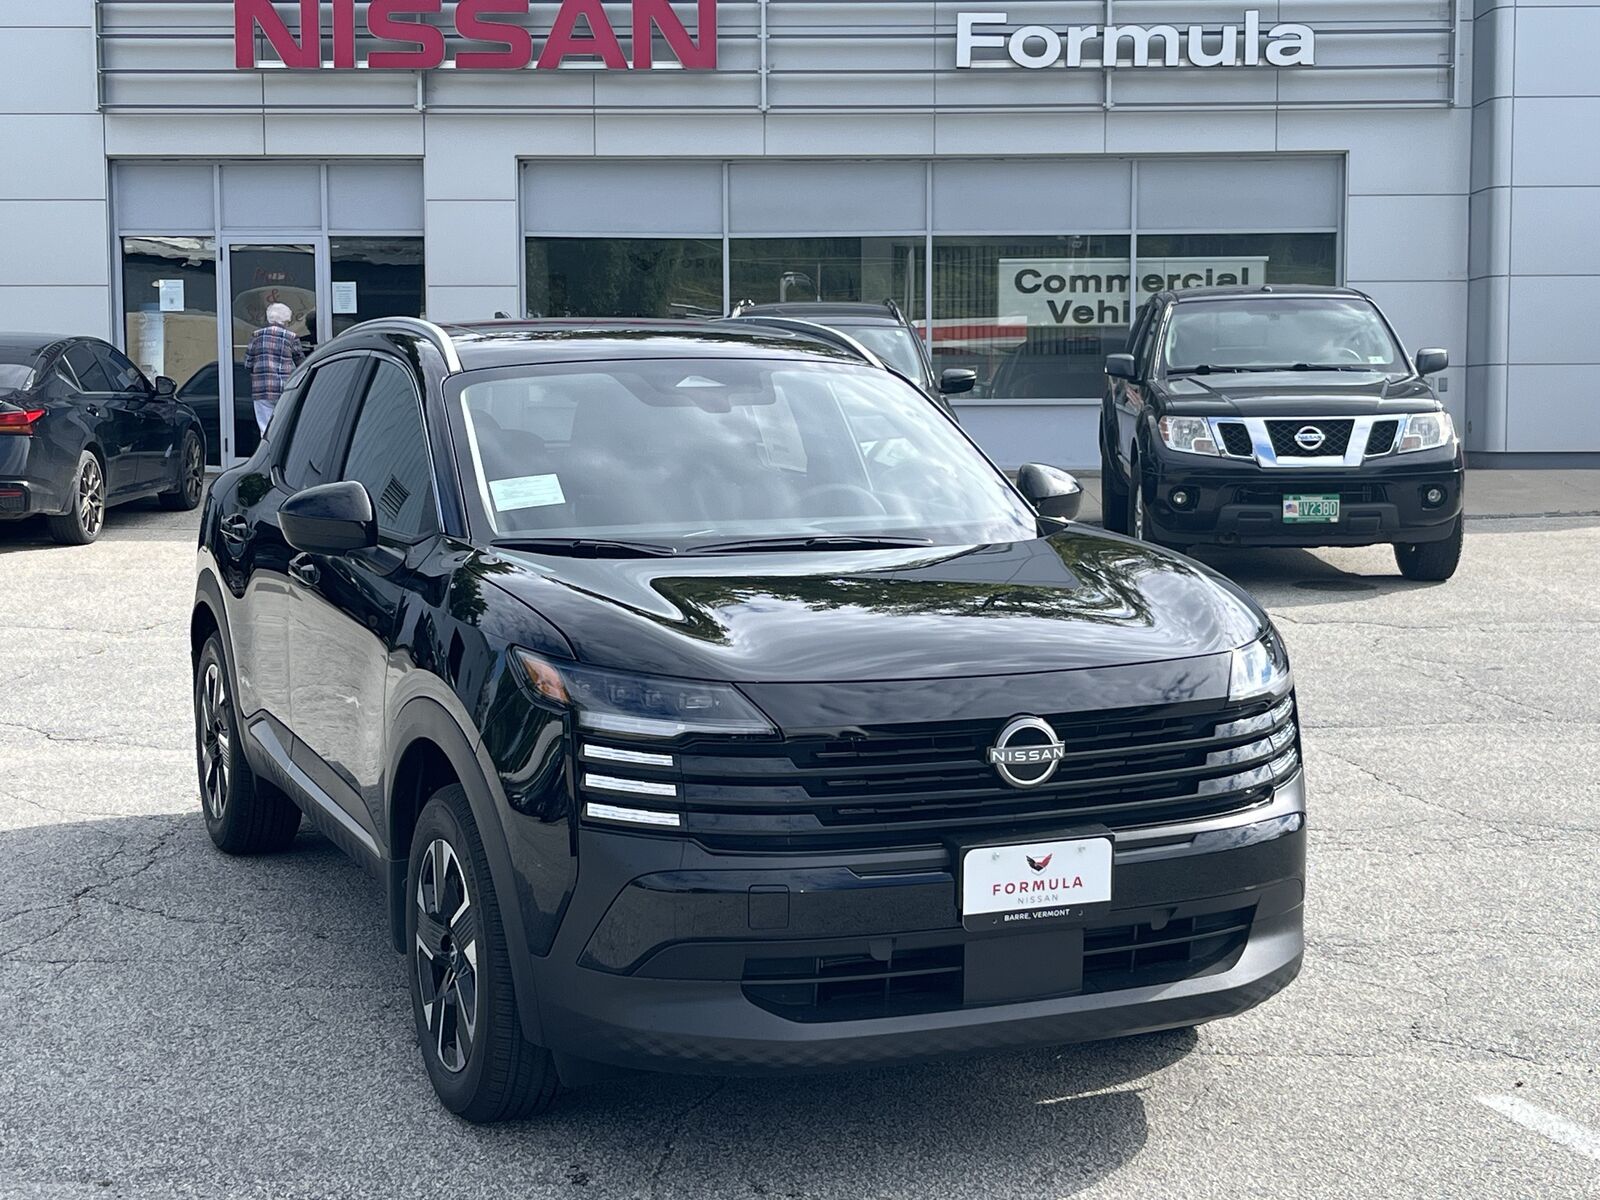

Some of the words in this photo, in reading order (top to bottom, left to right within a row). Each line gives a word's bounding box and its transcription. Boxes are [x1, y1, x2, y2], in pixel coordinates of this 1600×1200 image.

[235, 0, 717, 71] NISSAN
[956, 10, 1315, 69] Formula
[1014, 267, 1249, 294] Commercial
[992, 747, 1064, 762] NISSAN
[992, 876, 1083, 896] FORMULA
[1017, 894, 1059, 905] NISSAN
[1032, 908, 1070, 919] VERMONT
